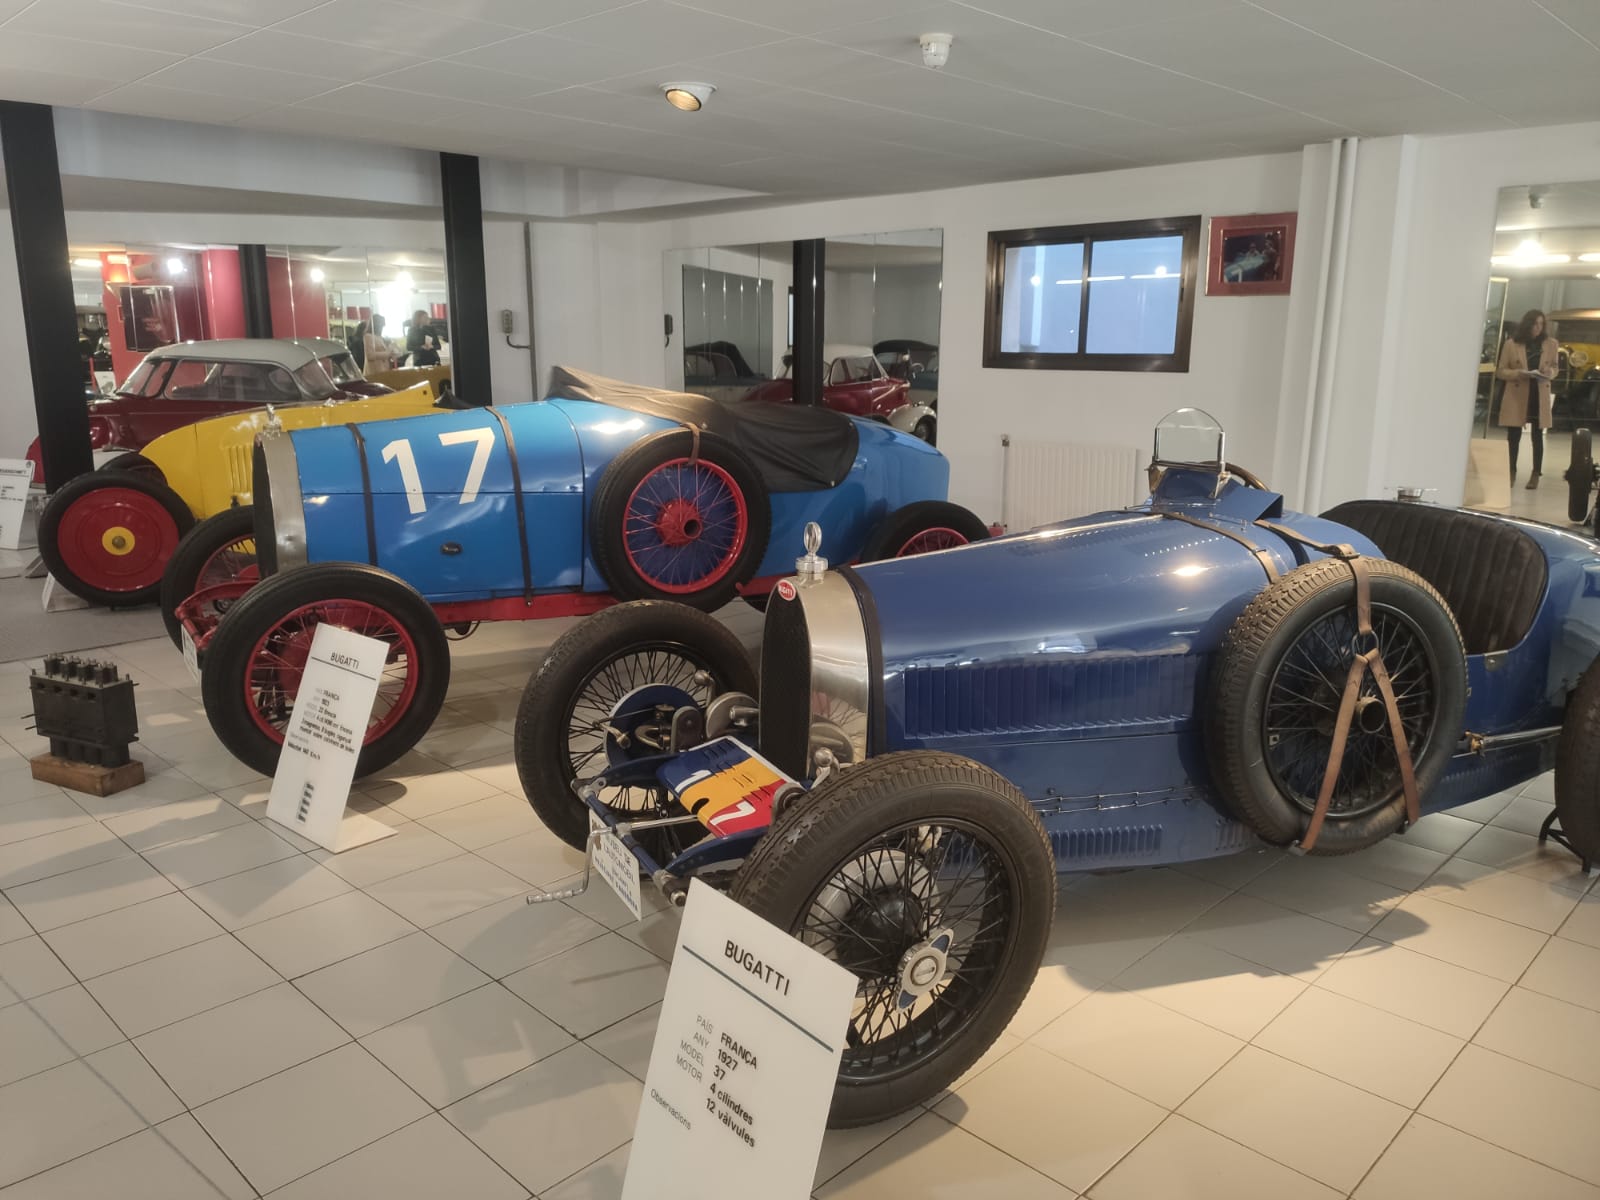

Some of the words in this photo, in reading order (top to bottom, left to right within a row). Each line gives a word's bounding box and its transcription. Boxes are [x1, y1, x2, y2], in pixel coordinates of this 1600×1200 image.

[381, 426, 496, 514] 17
[330, 652, 360, 669] BUGATTI
[724, 939, 790, 996] BUGATTI
[680, 1039, 704, 1066] MODEL
[713, 1065, 726, 1080] 37
[693, 1031, 710, 1049] ANY
[717, 1049, 738, 1071] 1927
[696, 1015, 714, 1034] PAÍS
[720, 1032, 758, 1069] FRANÇA
[650, 1088, 692, 1131] Observacions
[676, 1054, 703, 1083] MOTOR
[709, 1083, 717, 1094] 4
[717, 1090, 754, 1125] cilindres
[706, 1098, 716, 1114] 12
[718, 1108, 756, 1148] vàlvules
